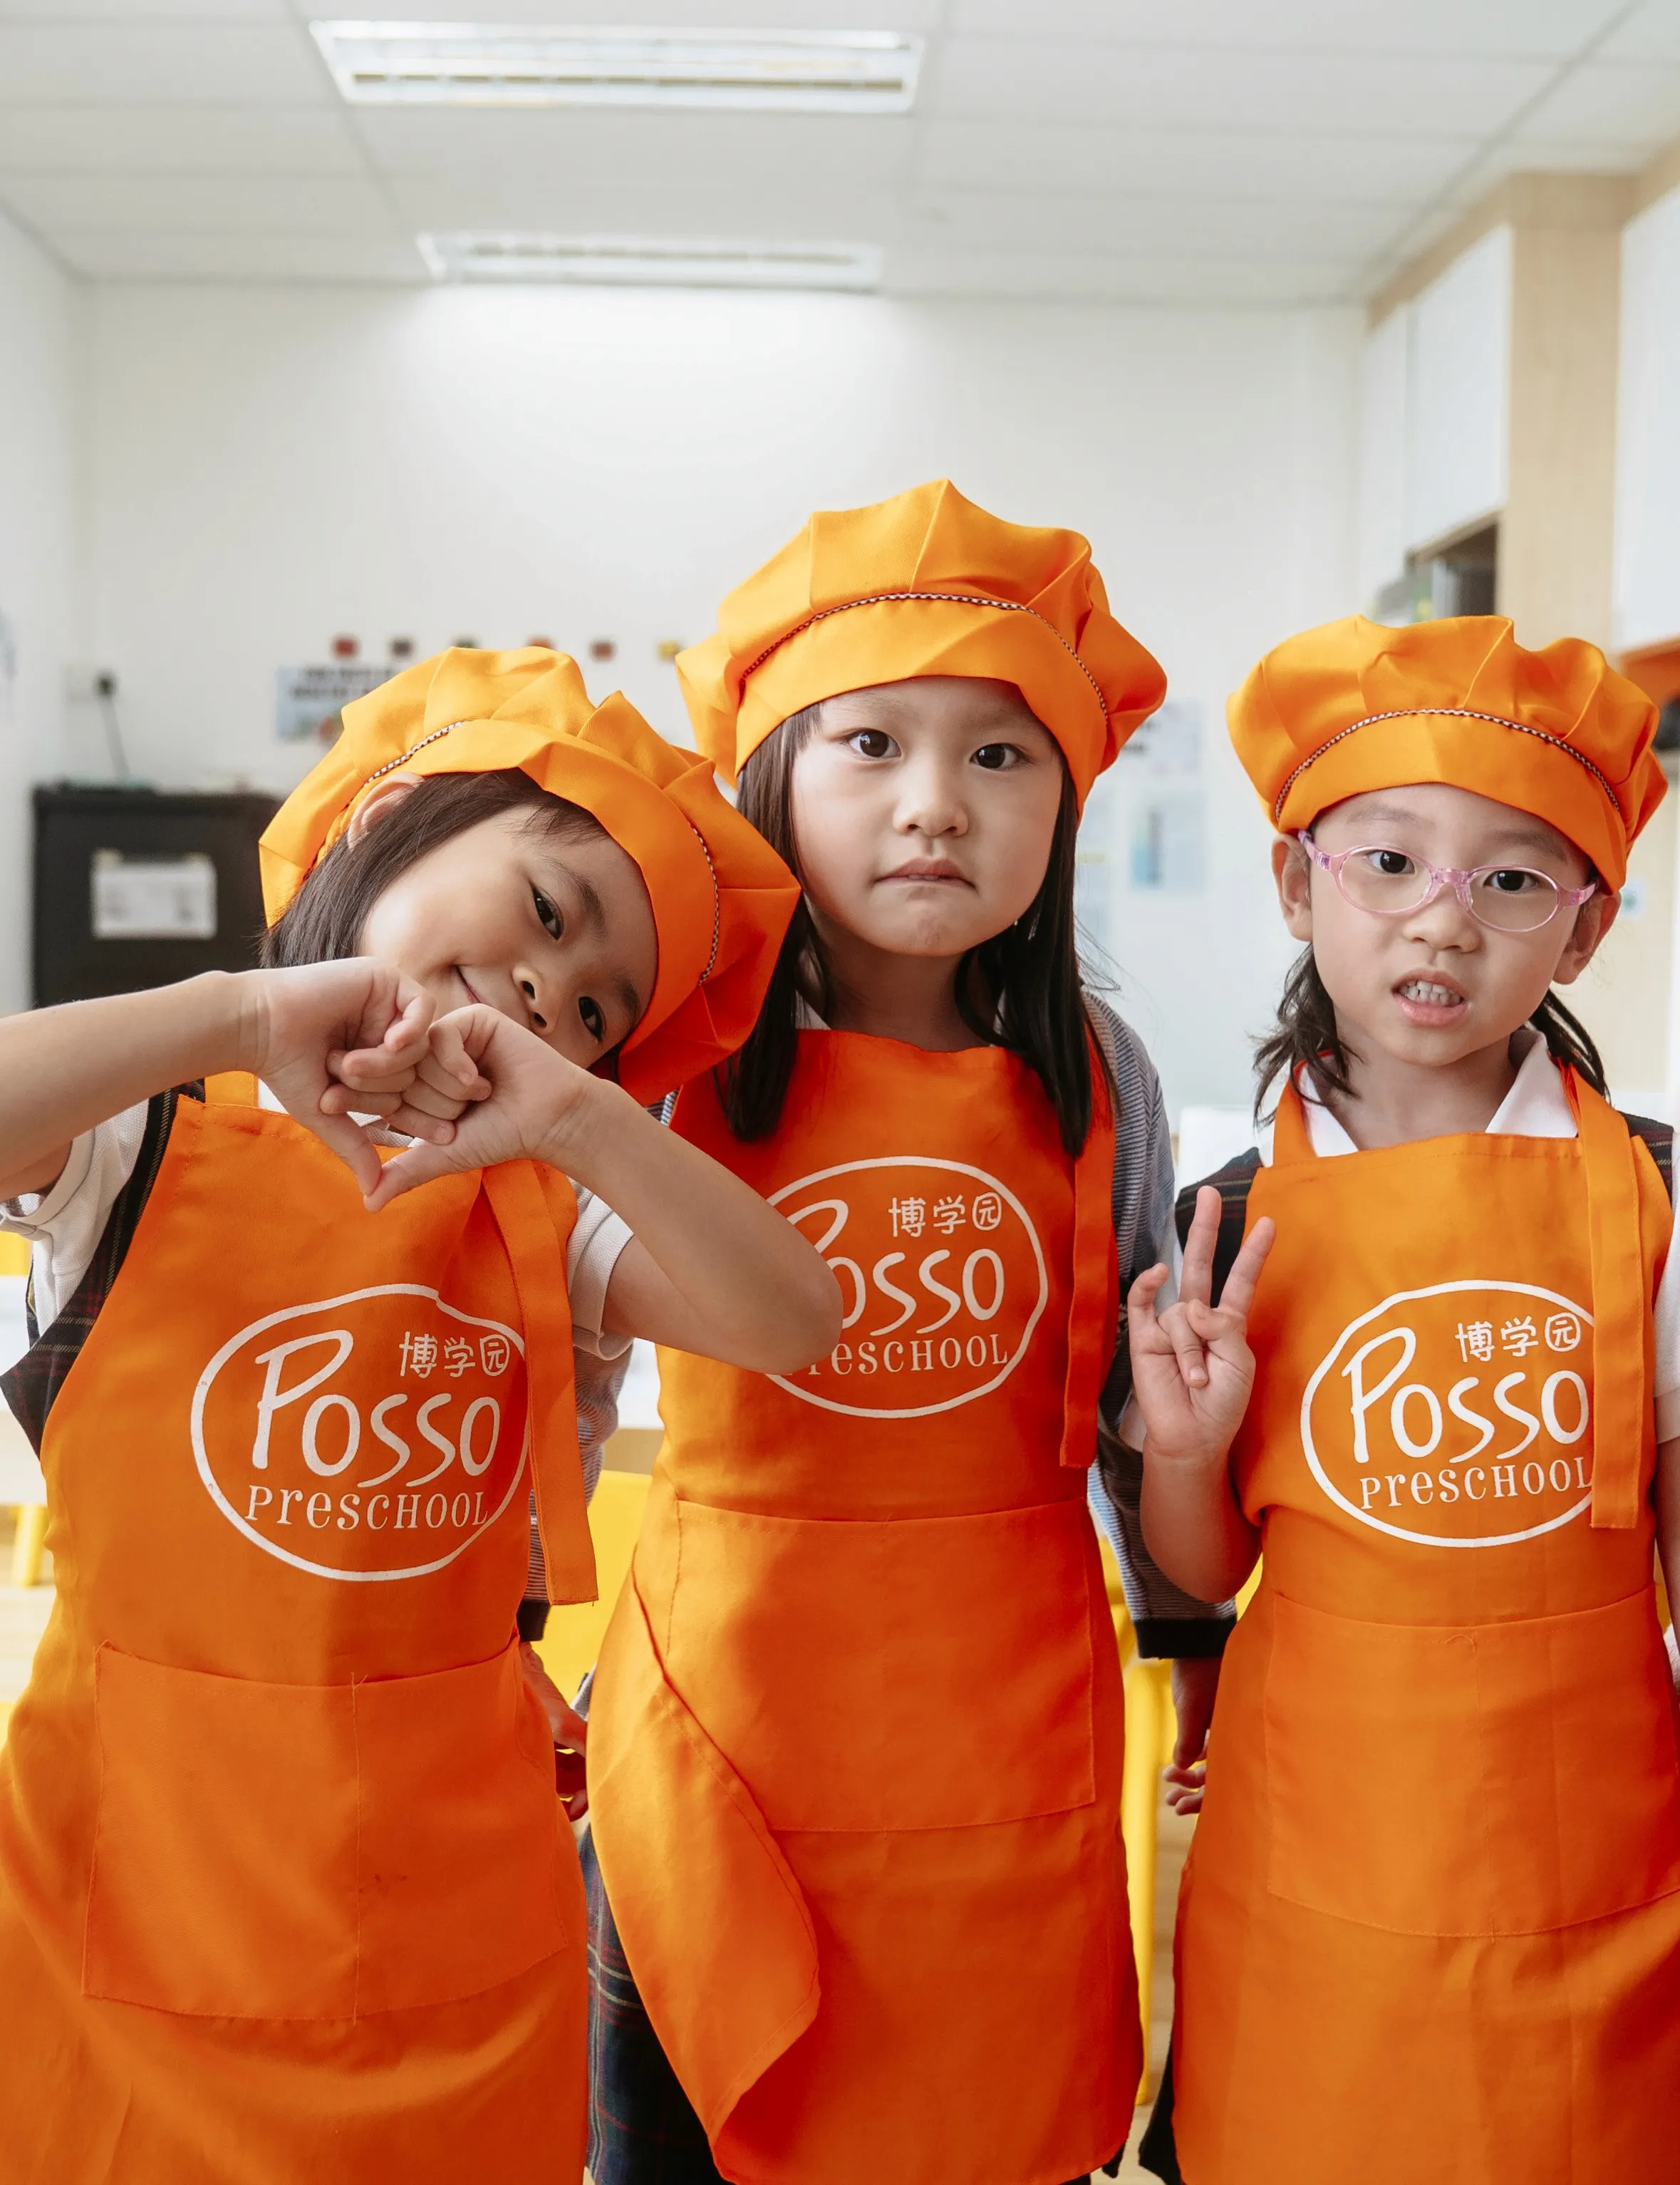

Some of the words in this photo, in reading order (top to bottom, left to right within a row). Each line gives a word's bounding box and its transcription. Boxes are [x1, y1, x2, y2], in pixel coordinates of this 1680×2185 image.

[888, 1192, 1002, 1238] 博学园
[399, 1331, 511, 1378] 博学园
[1454, 1312, 1582, 1363] 博学园
